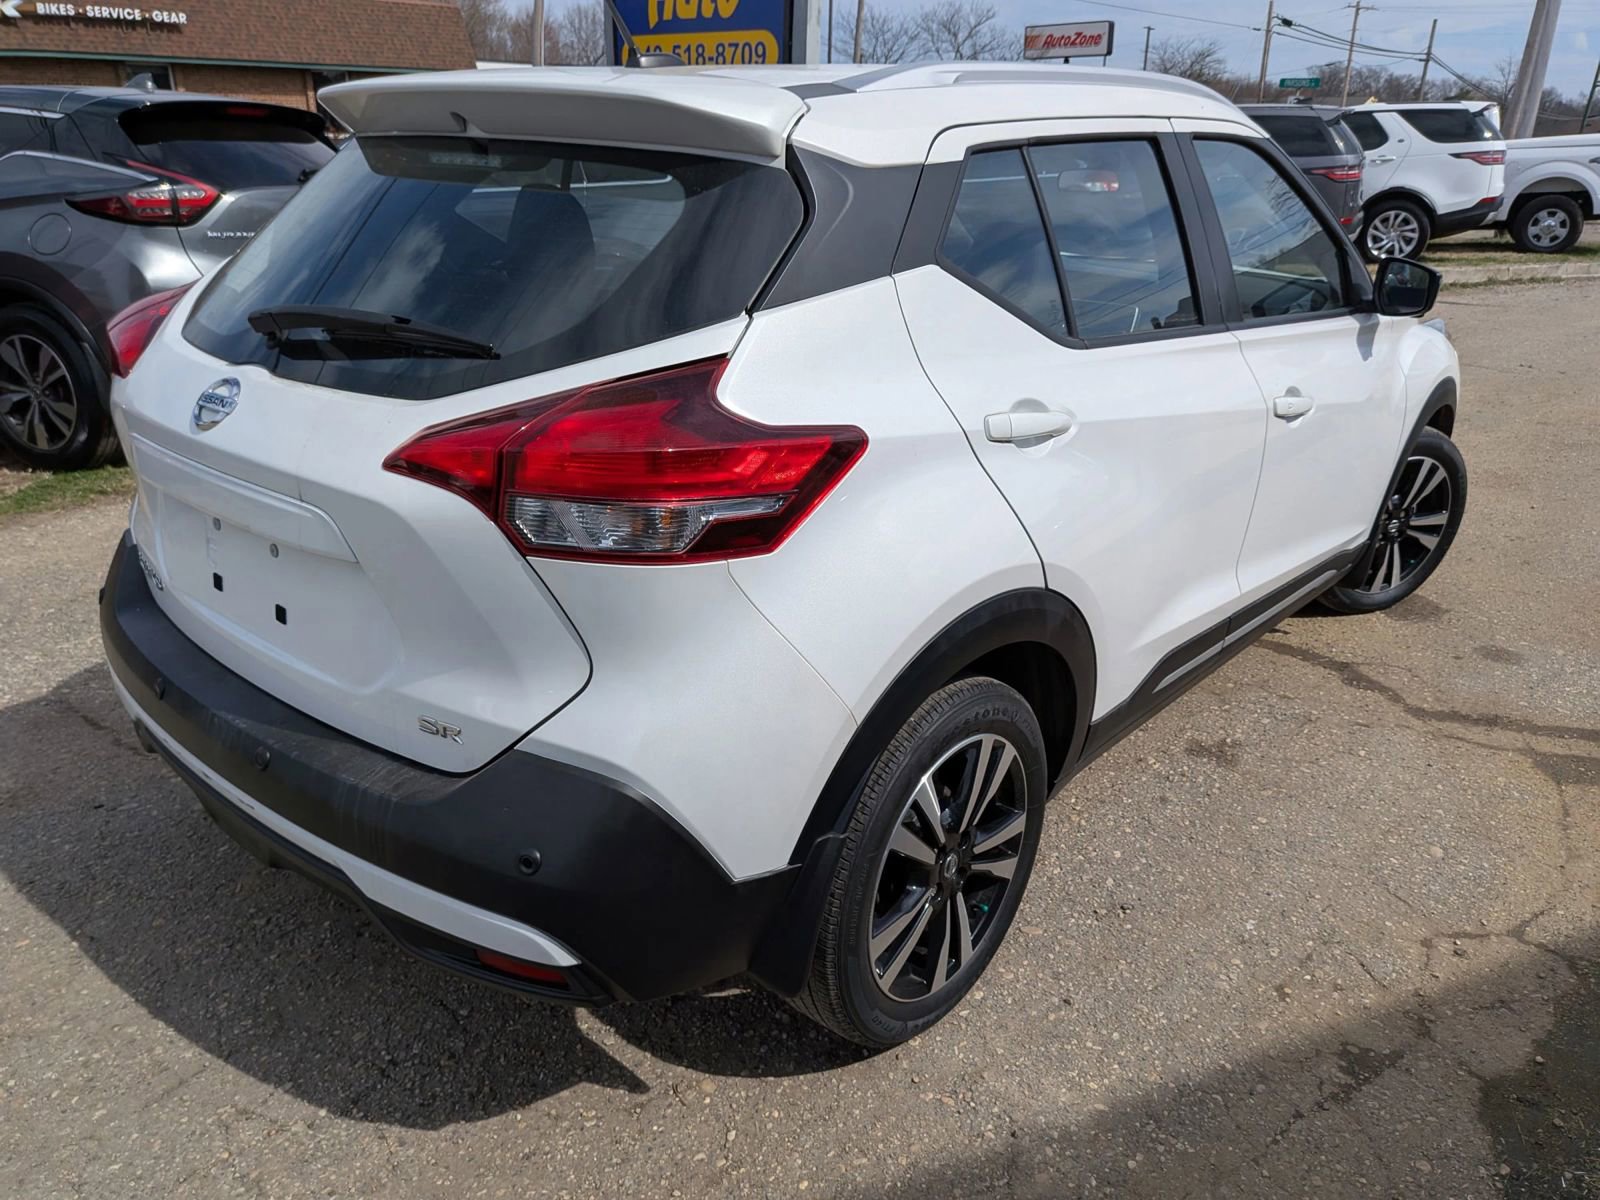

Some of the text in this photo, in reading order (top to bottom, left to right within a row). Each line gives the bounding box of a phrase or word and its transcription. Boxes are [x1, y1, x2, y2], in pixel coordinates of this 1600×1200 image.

[35, 2, 76, 16] BIKES
[85, 5, 142, 20] SERVICE
[151, 10, 188, 24] GEAR
[1042, 31, 1102, 50] AutoZone
[417, 714, 464, 745] SR
